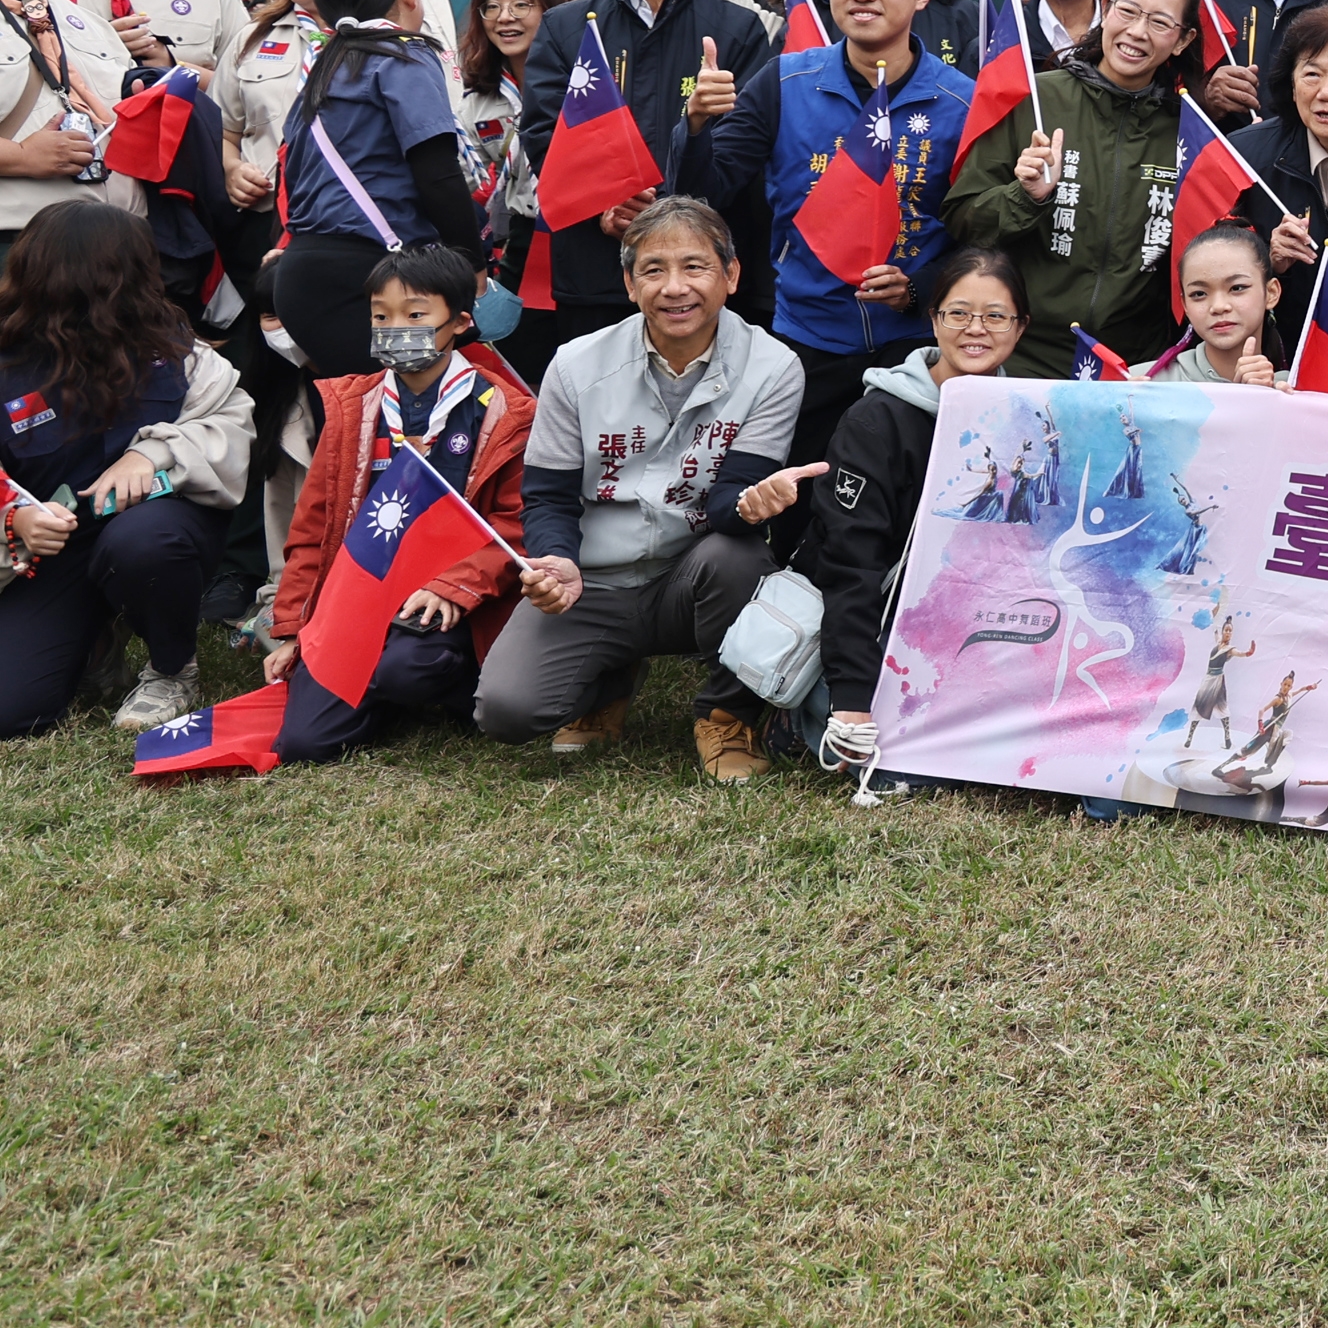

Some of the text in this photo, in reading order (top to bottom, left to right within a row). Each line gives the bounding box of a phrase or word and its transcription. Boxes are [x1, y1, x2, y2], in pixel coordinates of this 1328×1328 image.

[1050, 150, 1081, 257] 秘書 蘇佩瑜
[631, 424, 647, 454] 主任
[973, 610, 1052, 628] 永仁高中舞蹈班
